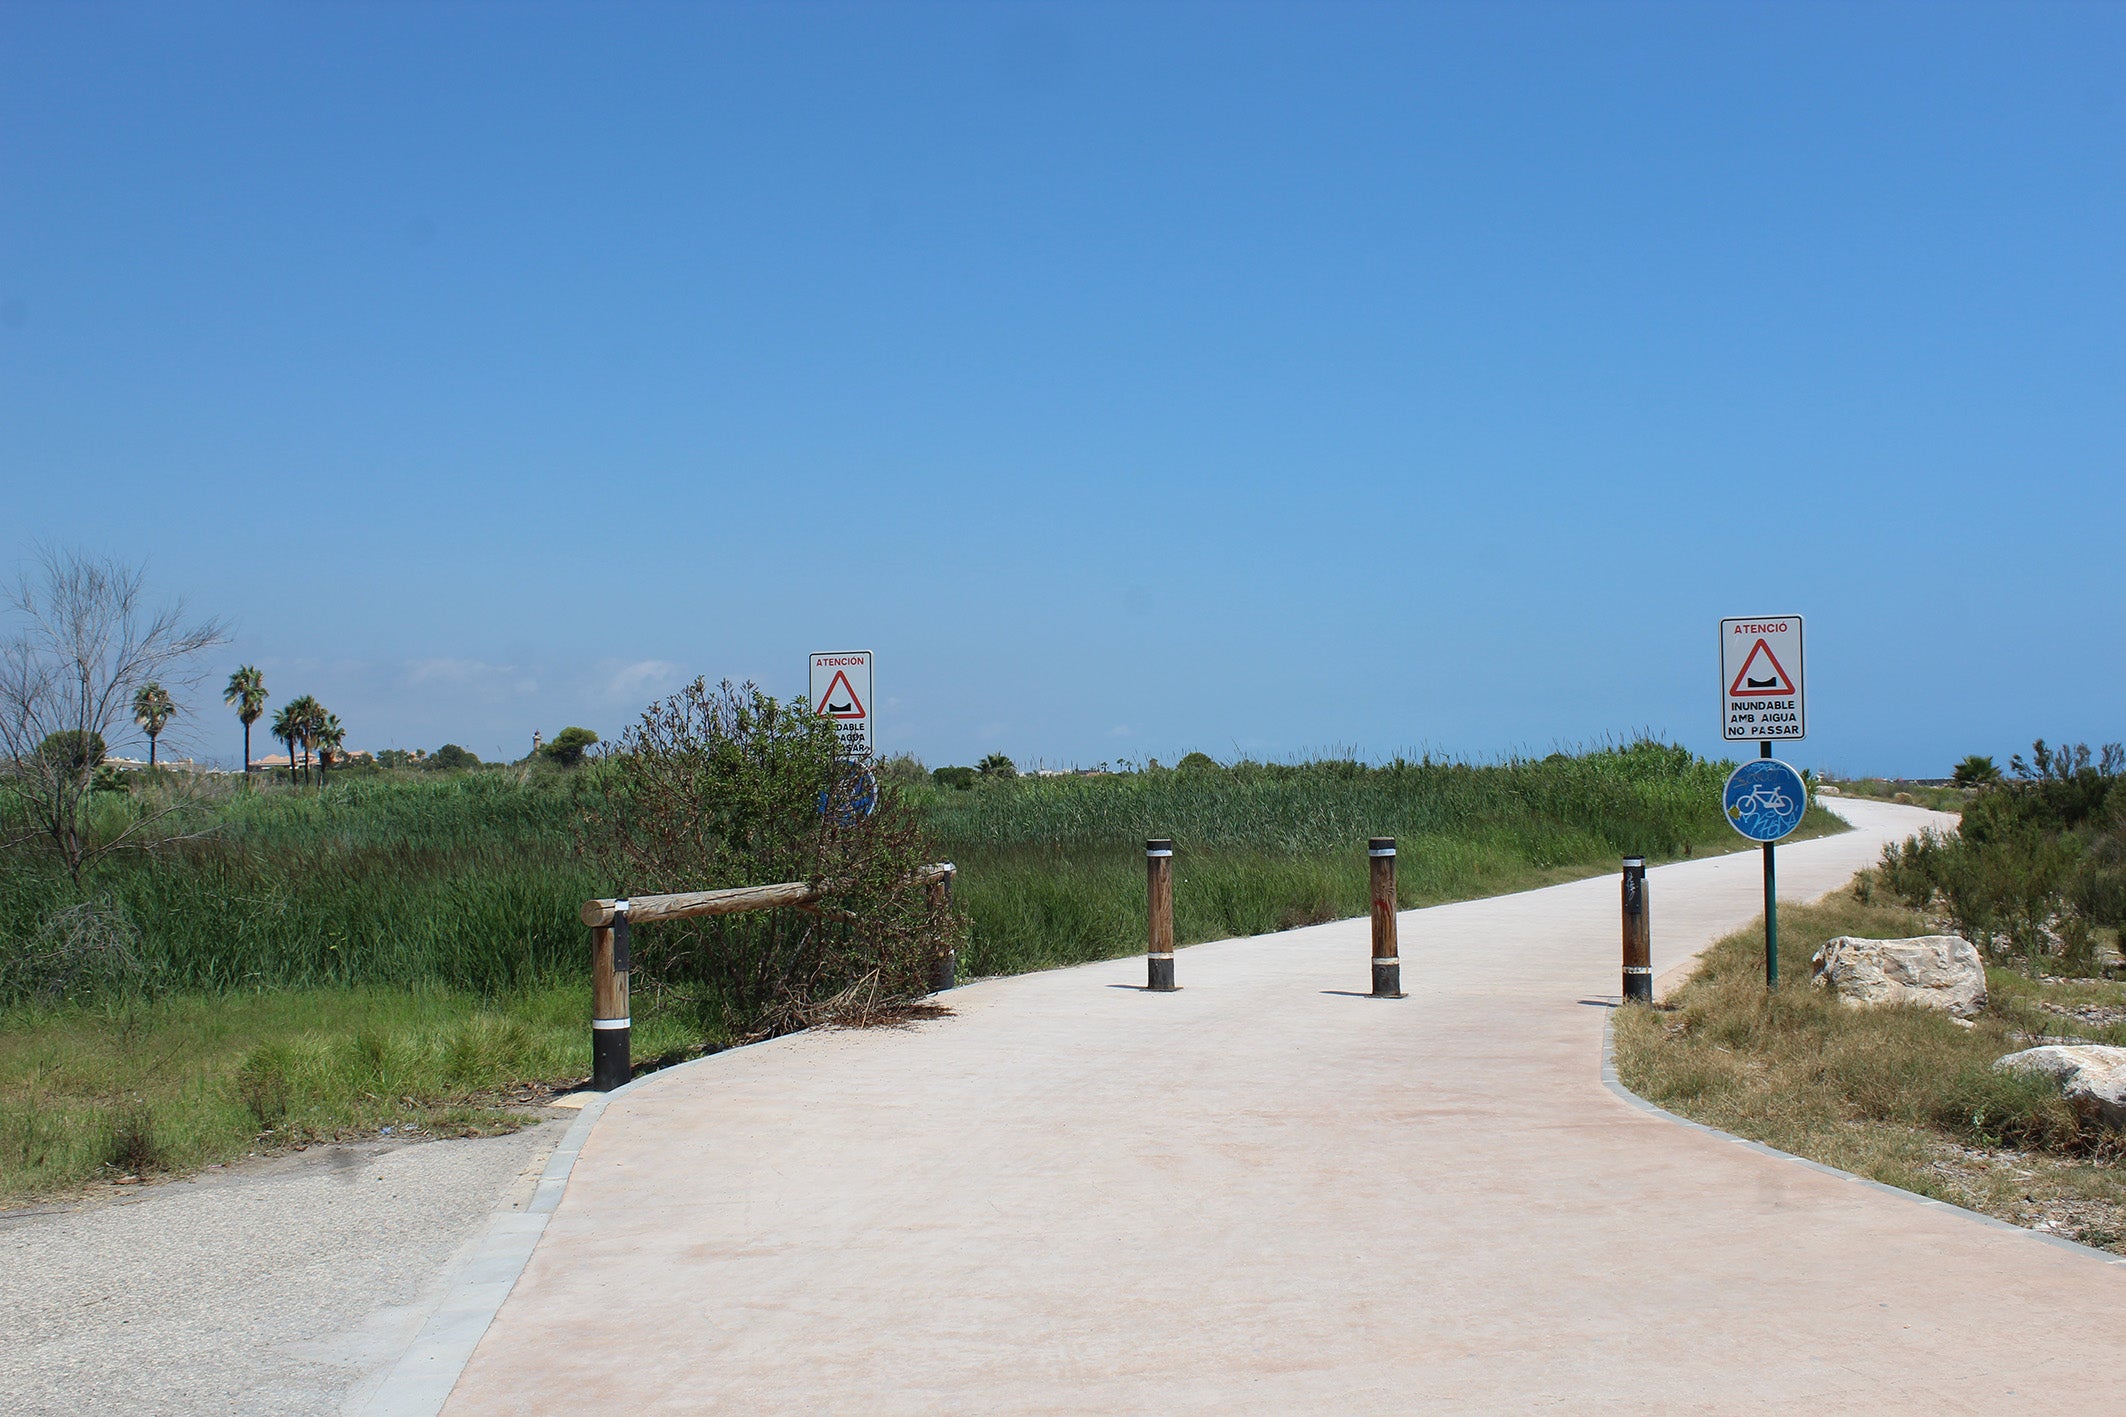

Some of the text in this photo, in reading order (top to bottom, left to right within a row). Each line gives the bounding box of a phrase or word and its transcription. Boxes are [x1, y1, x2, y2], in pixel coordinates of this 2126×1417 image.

[1734, 621, 1788, 634] ATENCIÓ
[816, 656, 864, 667] ATENCIÓN
[1731, 700, 1795, 711] INUNDABLE
[1730, 712, 1797, 723] AMB AIGUA
[1728, 725, 1799, 736] NO PASSAR
[840, 733, 865, 742] AGUA
